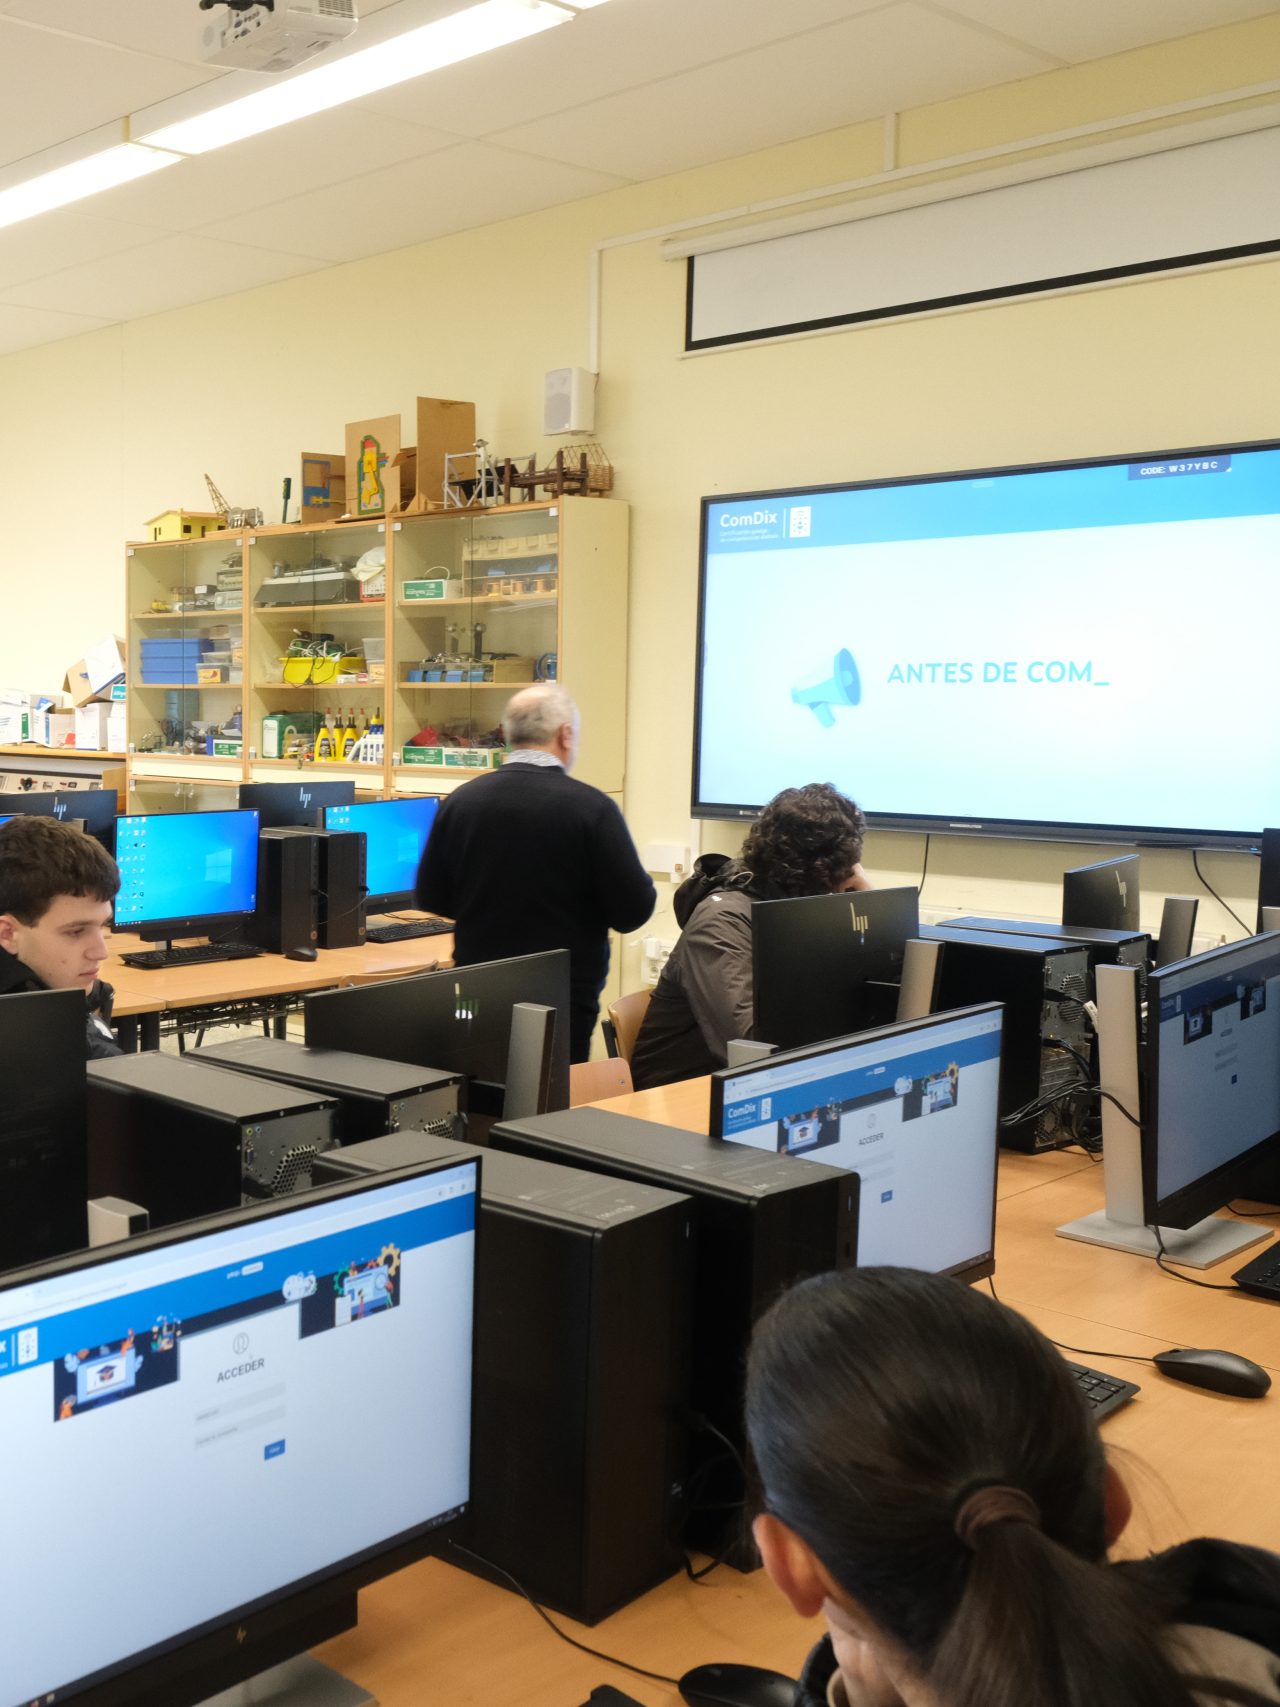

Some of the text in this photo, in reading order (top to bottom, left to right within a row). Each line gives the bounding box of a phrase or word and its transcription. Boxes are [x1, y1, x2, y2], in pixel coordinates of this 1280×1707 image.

[720, 510, 778, 528] ComDix
[887, 662, 974, 684] ANTES
[983, 661, 1018, 683] DE
[728, 1104, 756, 1119] ComDix
[216, 1358, 265, 1383] ACCEDER
